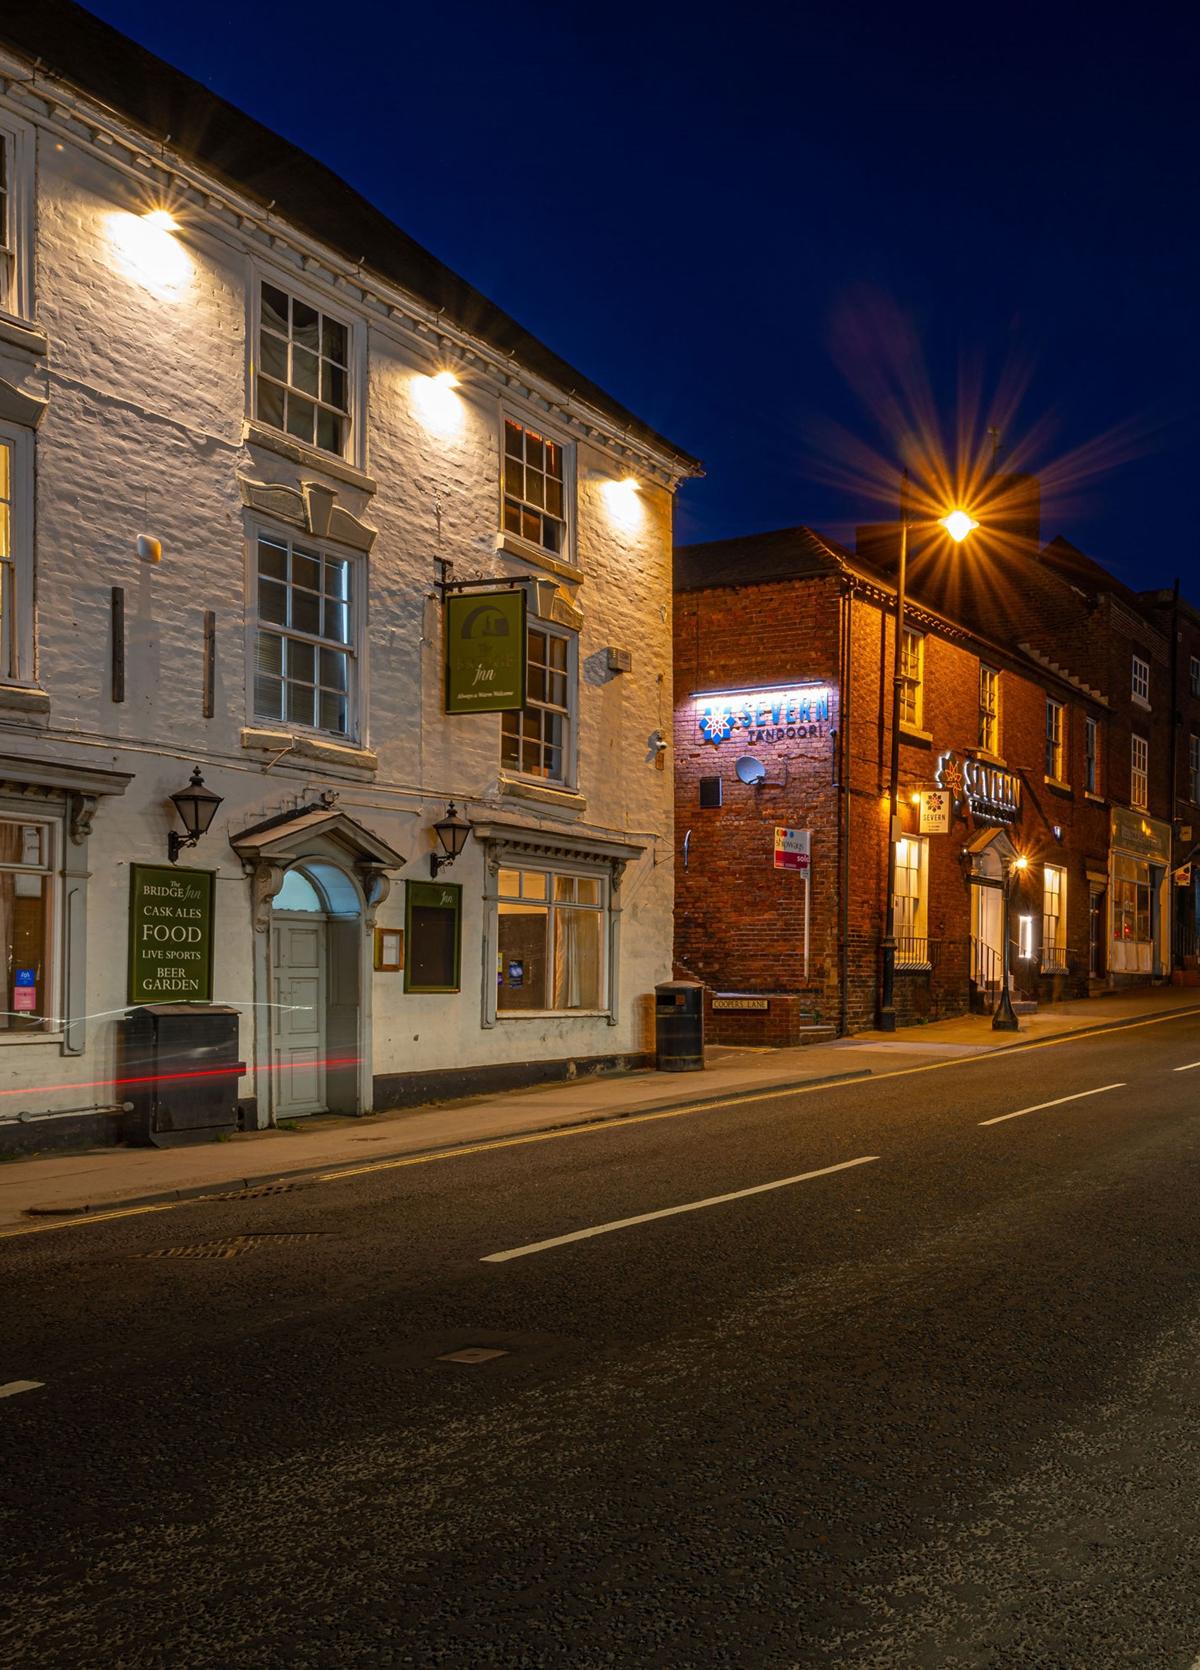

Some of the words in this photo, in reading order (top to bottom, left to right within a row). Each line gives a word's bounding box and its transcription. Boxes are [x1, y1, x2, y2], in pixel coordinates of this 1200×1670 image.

[741, 691, 829, 728] SEVERN
[748, 724, 822, 742] TANDOORI
[143, 885, 184, 898] BRIDGE
[143, 905, 173, 917] CASK
[175, 908, 202, 919] ALES
[142, 924, 202, 942] FOOD
[142, 950, 164, 959] LIVE
[165, 951, 202, 960] SPORTS
[157, 967, 186, 978] BEER
[142, 979, 199, 991] GARDEN
